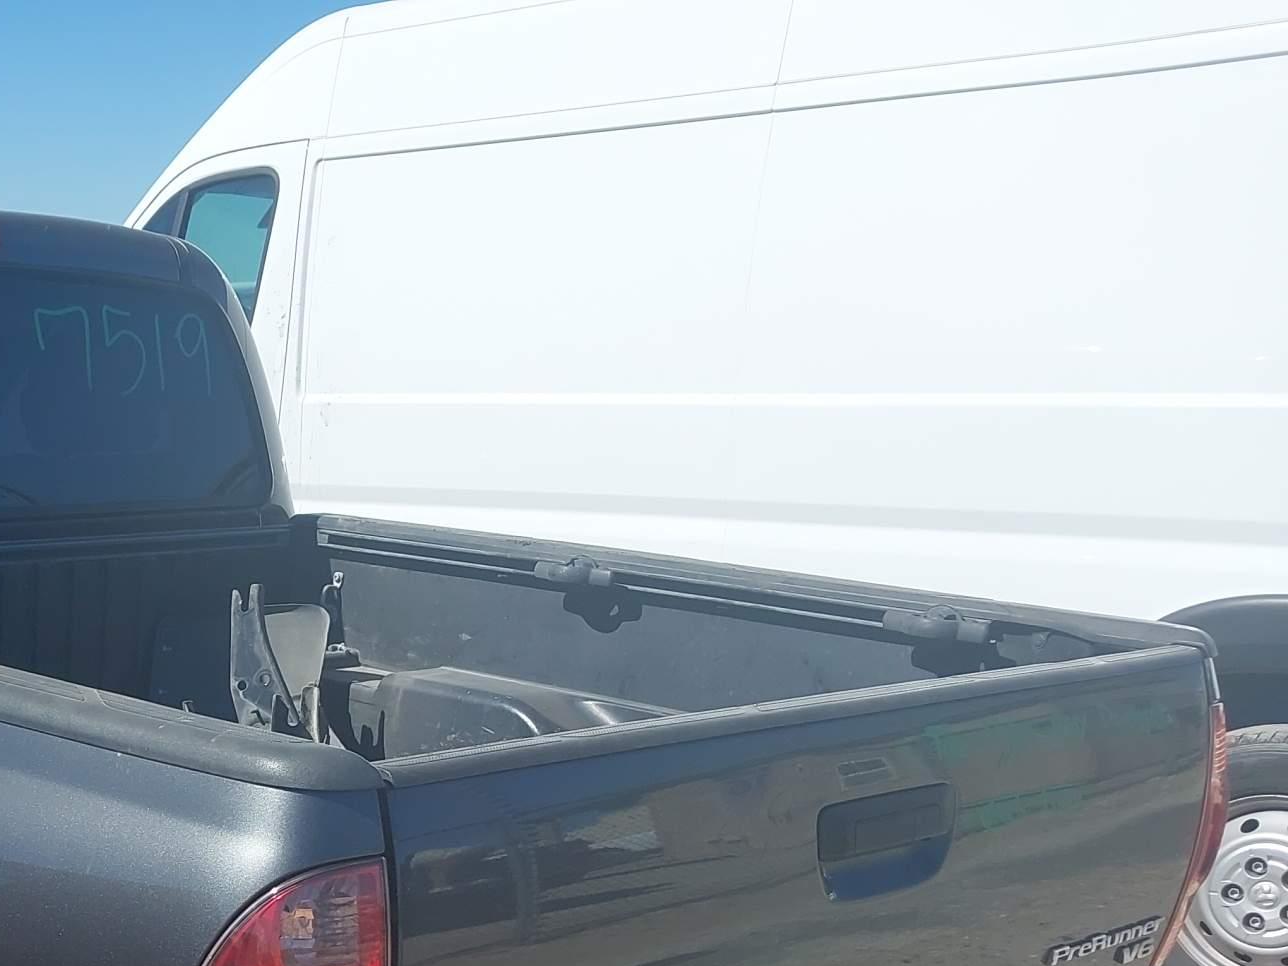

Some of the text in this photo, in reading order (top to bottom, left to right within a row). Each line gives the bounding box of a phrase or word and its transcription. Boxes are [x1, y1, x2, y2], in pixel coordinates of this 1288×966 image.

[34, 305, 211, 397] 7519
[1049, 916, 1166, 966] PreRunner
[1120, 938, 1155, 965] V6
